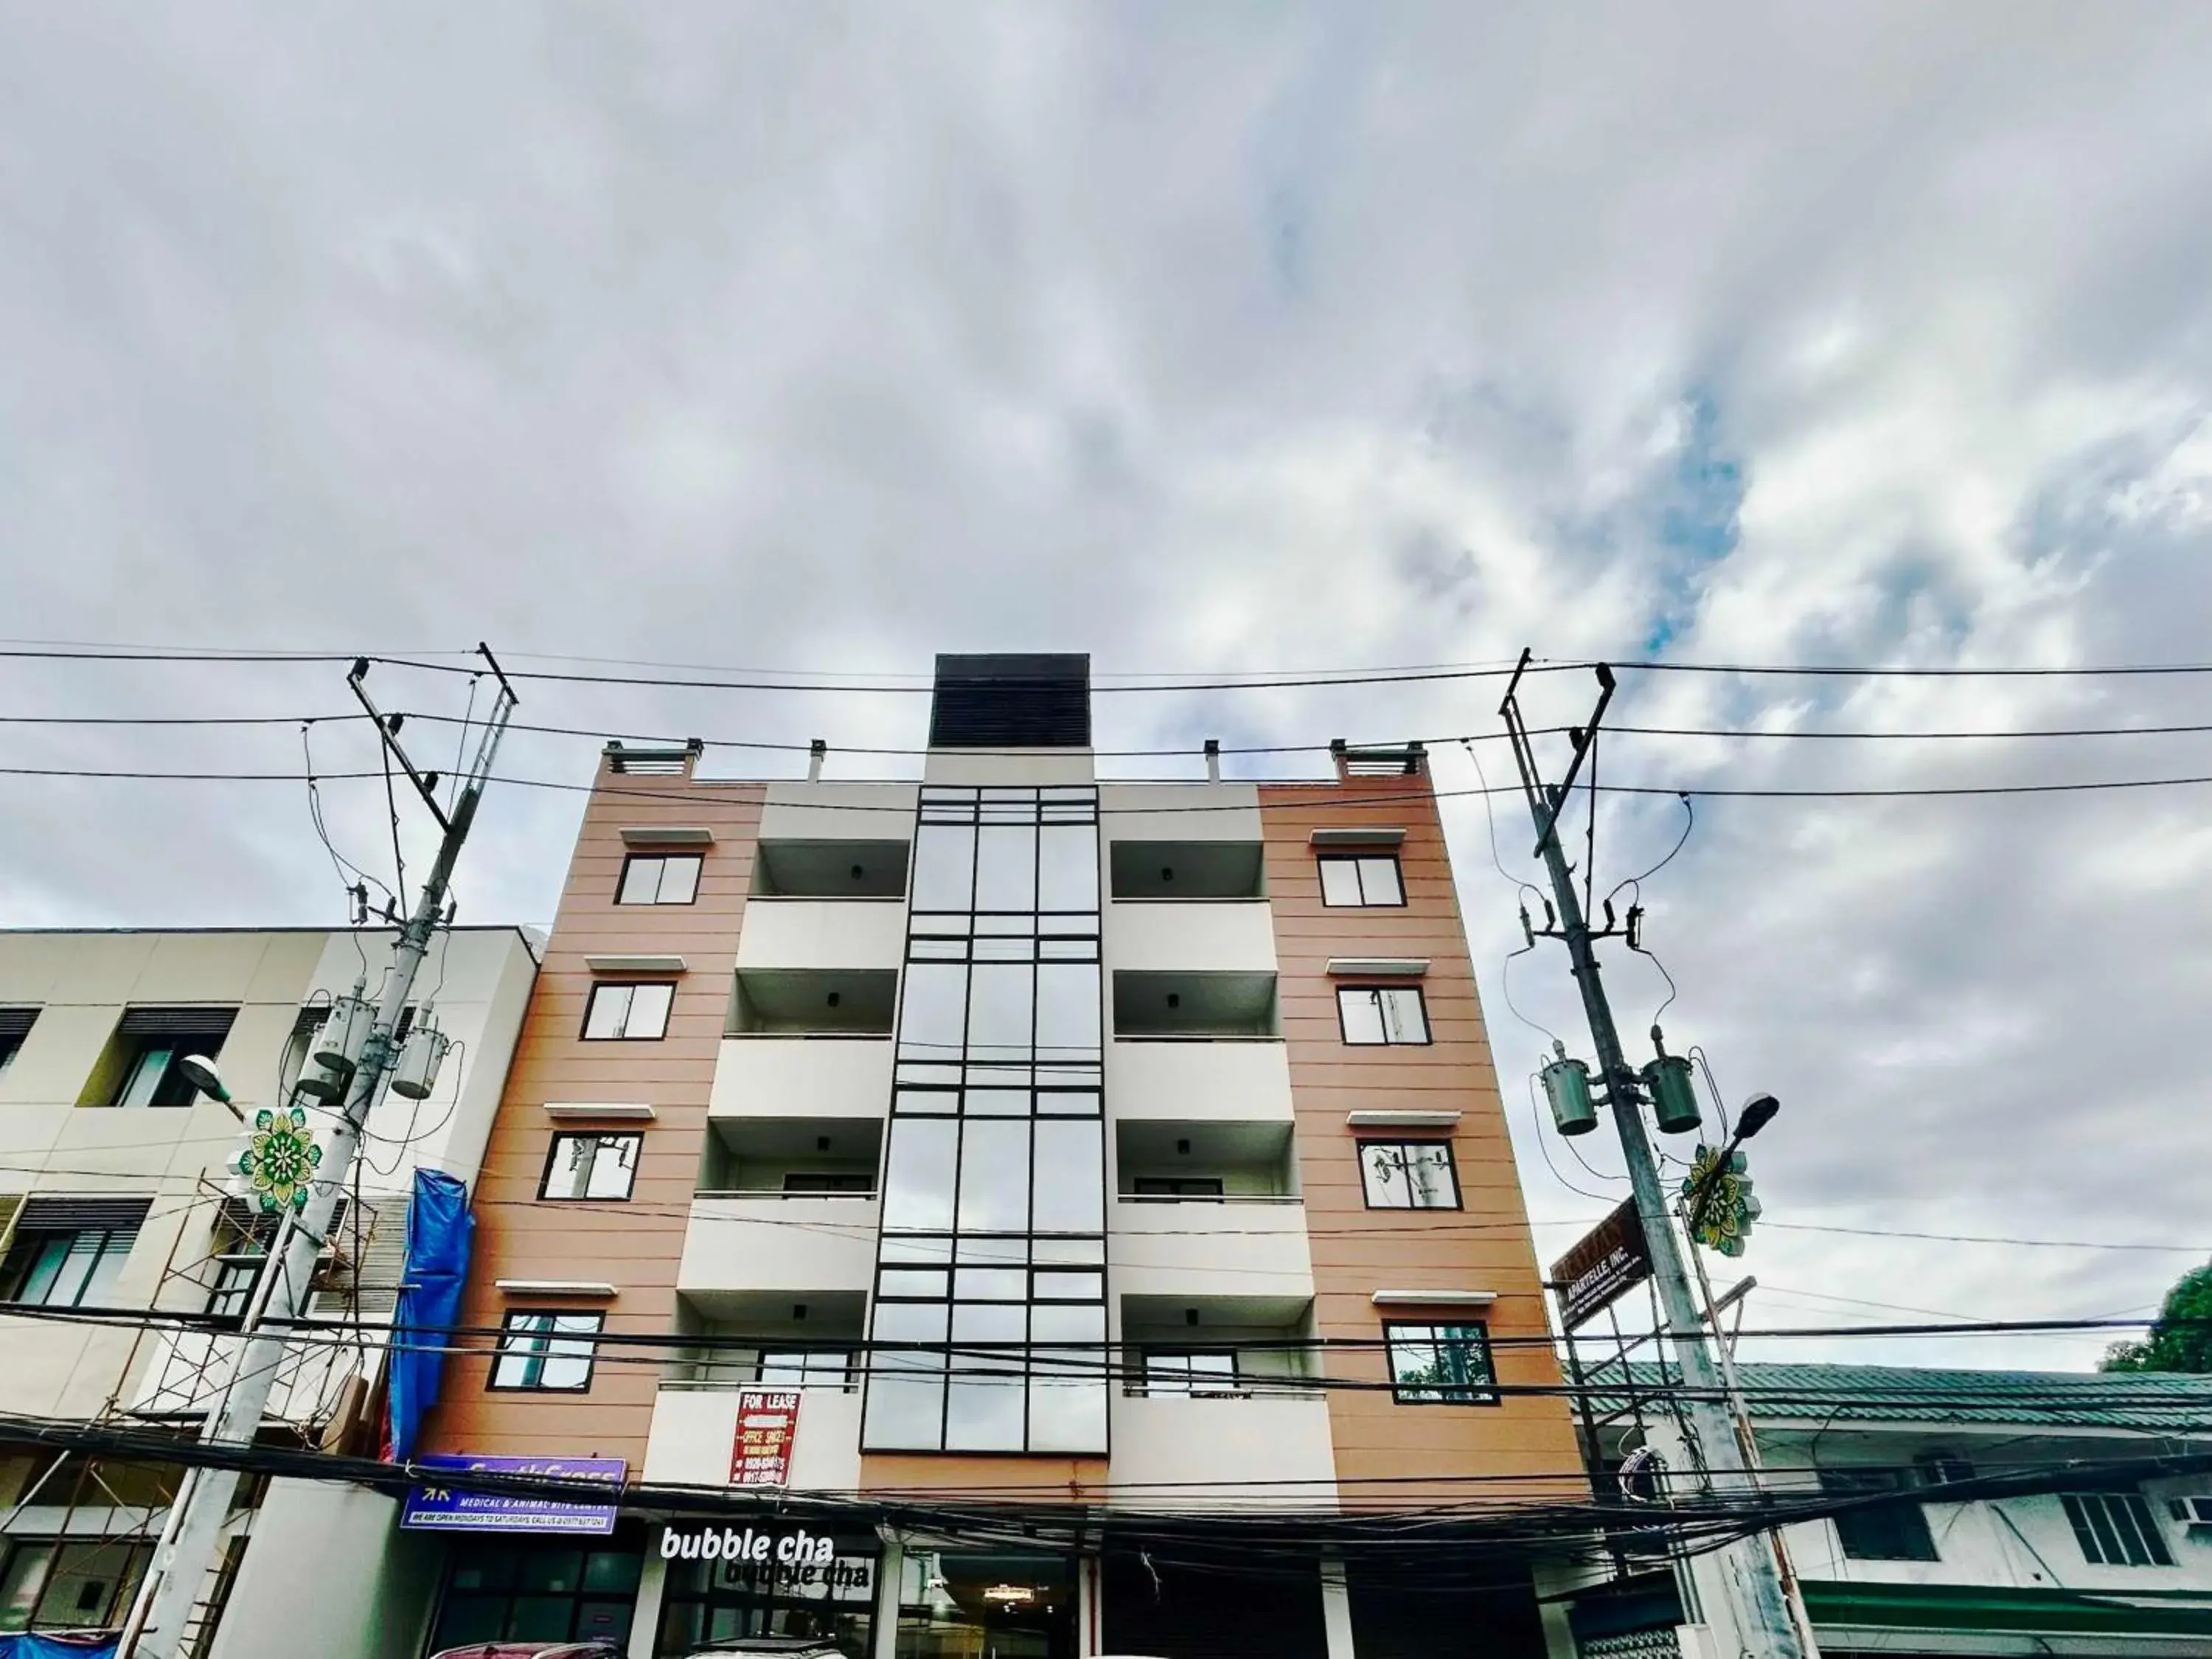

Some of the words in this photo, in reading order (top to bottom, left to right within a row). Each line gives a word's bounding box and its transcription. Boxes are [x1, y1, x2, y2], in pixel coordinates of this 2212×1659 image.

[743, 1393, 763, 1409] FOR
[767, 1394, 797, 1410] LEASE
[459, 1498, 500, 1508] MEDICAL
[502, 1498, 510, 1508] &
[511, 1499, 550, 1509] ANIMAL
[436, 1514, 453, 1522] OPEN
[455, 1514, 484, 1523] MONDAYS
[660, 1527, 771, 1560] bubble
[776, 1529, 834, 1562] cha
